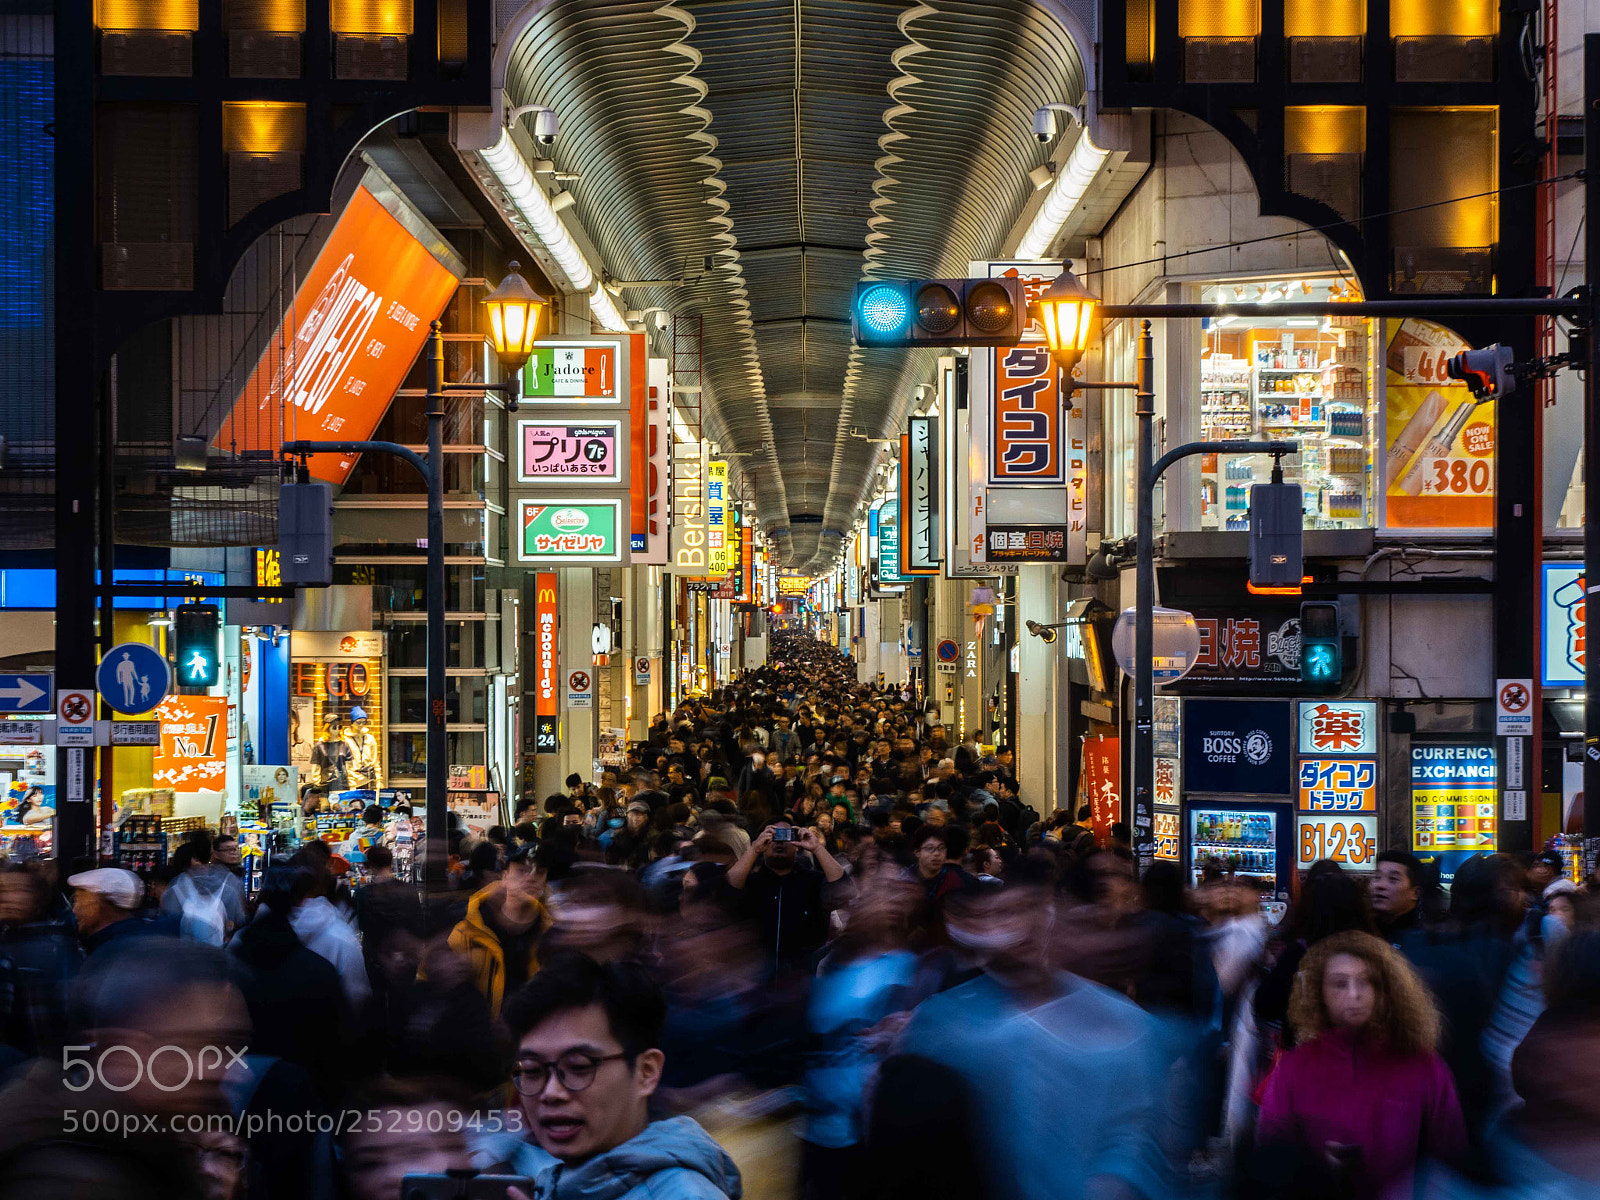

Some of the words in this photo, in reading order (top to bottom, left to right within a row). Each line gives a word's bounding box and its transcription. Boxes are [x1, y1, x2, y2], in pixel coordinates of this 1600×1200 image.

[544, 363, 596, 376] J'adore
[1002, 346, 1050, 474] ダイコク
[1465, 426, 1490, 437] NOW
[1470, 434, 1488, 444] ON
[533, 437, 582, 463] プリ
[587, 444, 605, 459] 7F
[532, 463, 598, 473] いっぱいあるで
[1071, 438, 1083, 532] ヒロタビル
[526, 507, 540, 517] 6F
[676, 452, 705, 567] Bershka
[975, 495, 983, 517] 1F
[536, 535, 604, 551] サイゼリヤ
[973, 534, 984, 554] 4F
[990, 531, 1064, 550] 個室日焼
[540, 613, 553, 699] McDonald's
[966, 641, 977, 678] ZARA
[0, 722, 41, 734] 転車を除く
[1310, 708, 1366, 751] 薬
[537, 735, 555, 746] 24
[1202, 737, 1242, 754] BOSS
[1207, 754, 1237, 763] COFFEE
[1300, 761, 1375, 790] ダイコク
[1308, 790, 1364, 810] ドラッグ
[1414, 795, 1428, 803] NO
[1431, 795, 1490, 803] COMMISSION
